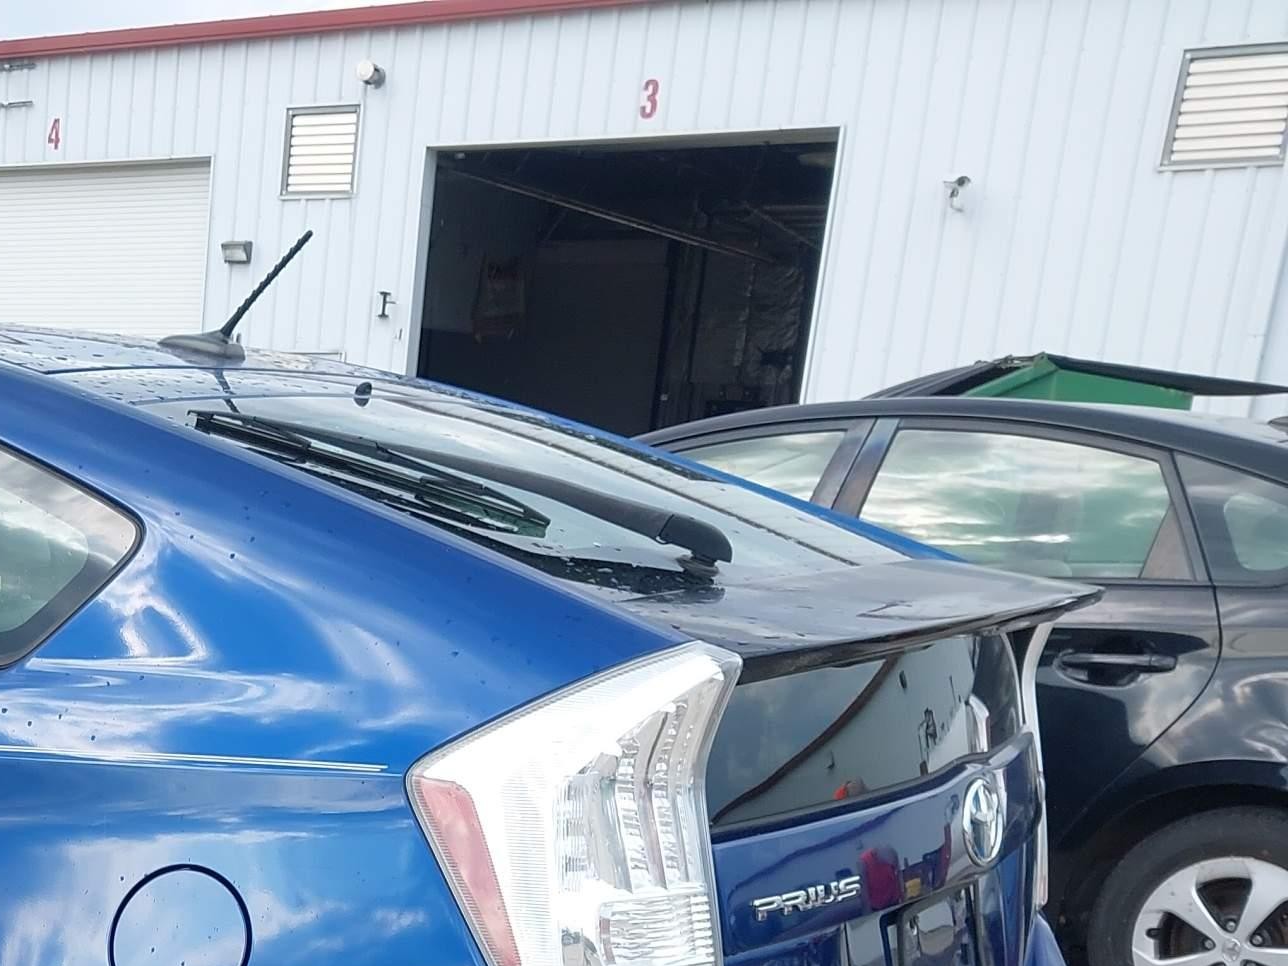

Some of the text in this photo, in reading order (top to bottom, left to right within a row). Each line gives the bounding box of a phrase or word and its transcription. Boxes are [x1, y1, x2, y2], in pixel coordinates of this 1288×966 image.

[639, 79, 659, 119] 3
[47, 118, 60, 150] 4
[750, 876, 861, 921] PRIUS
